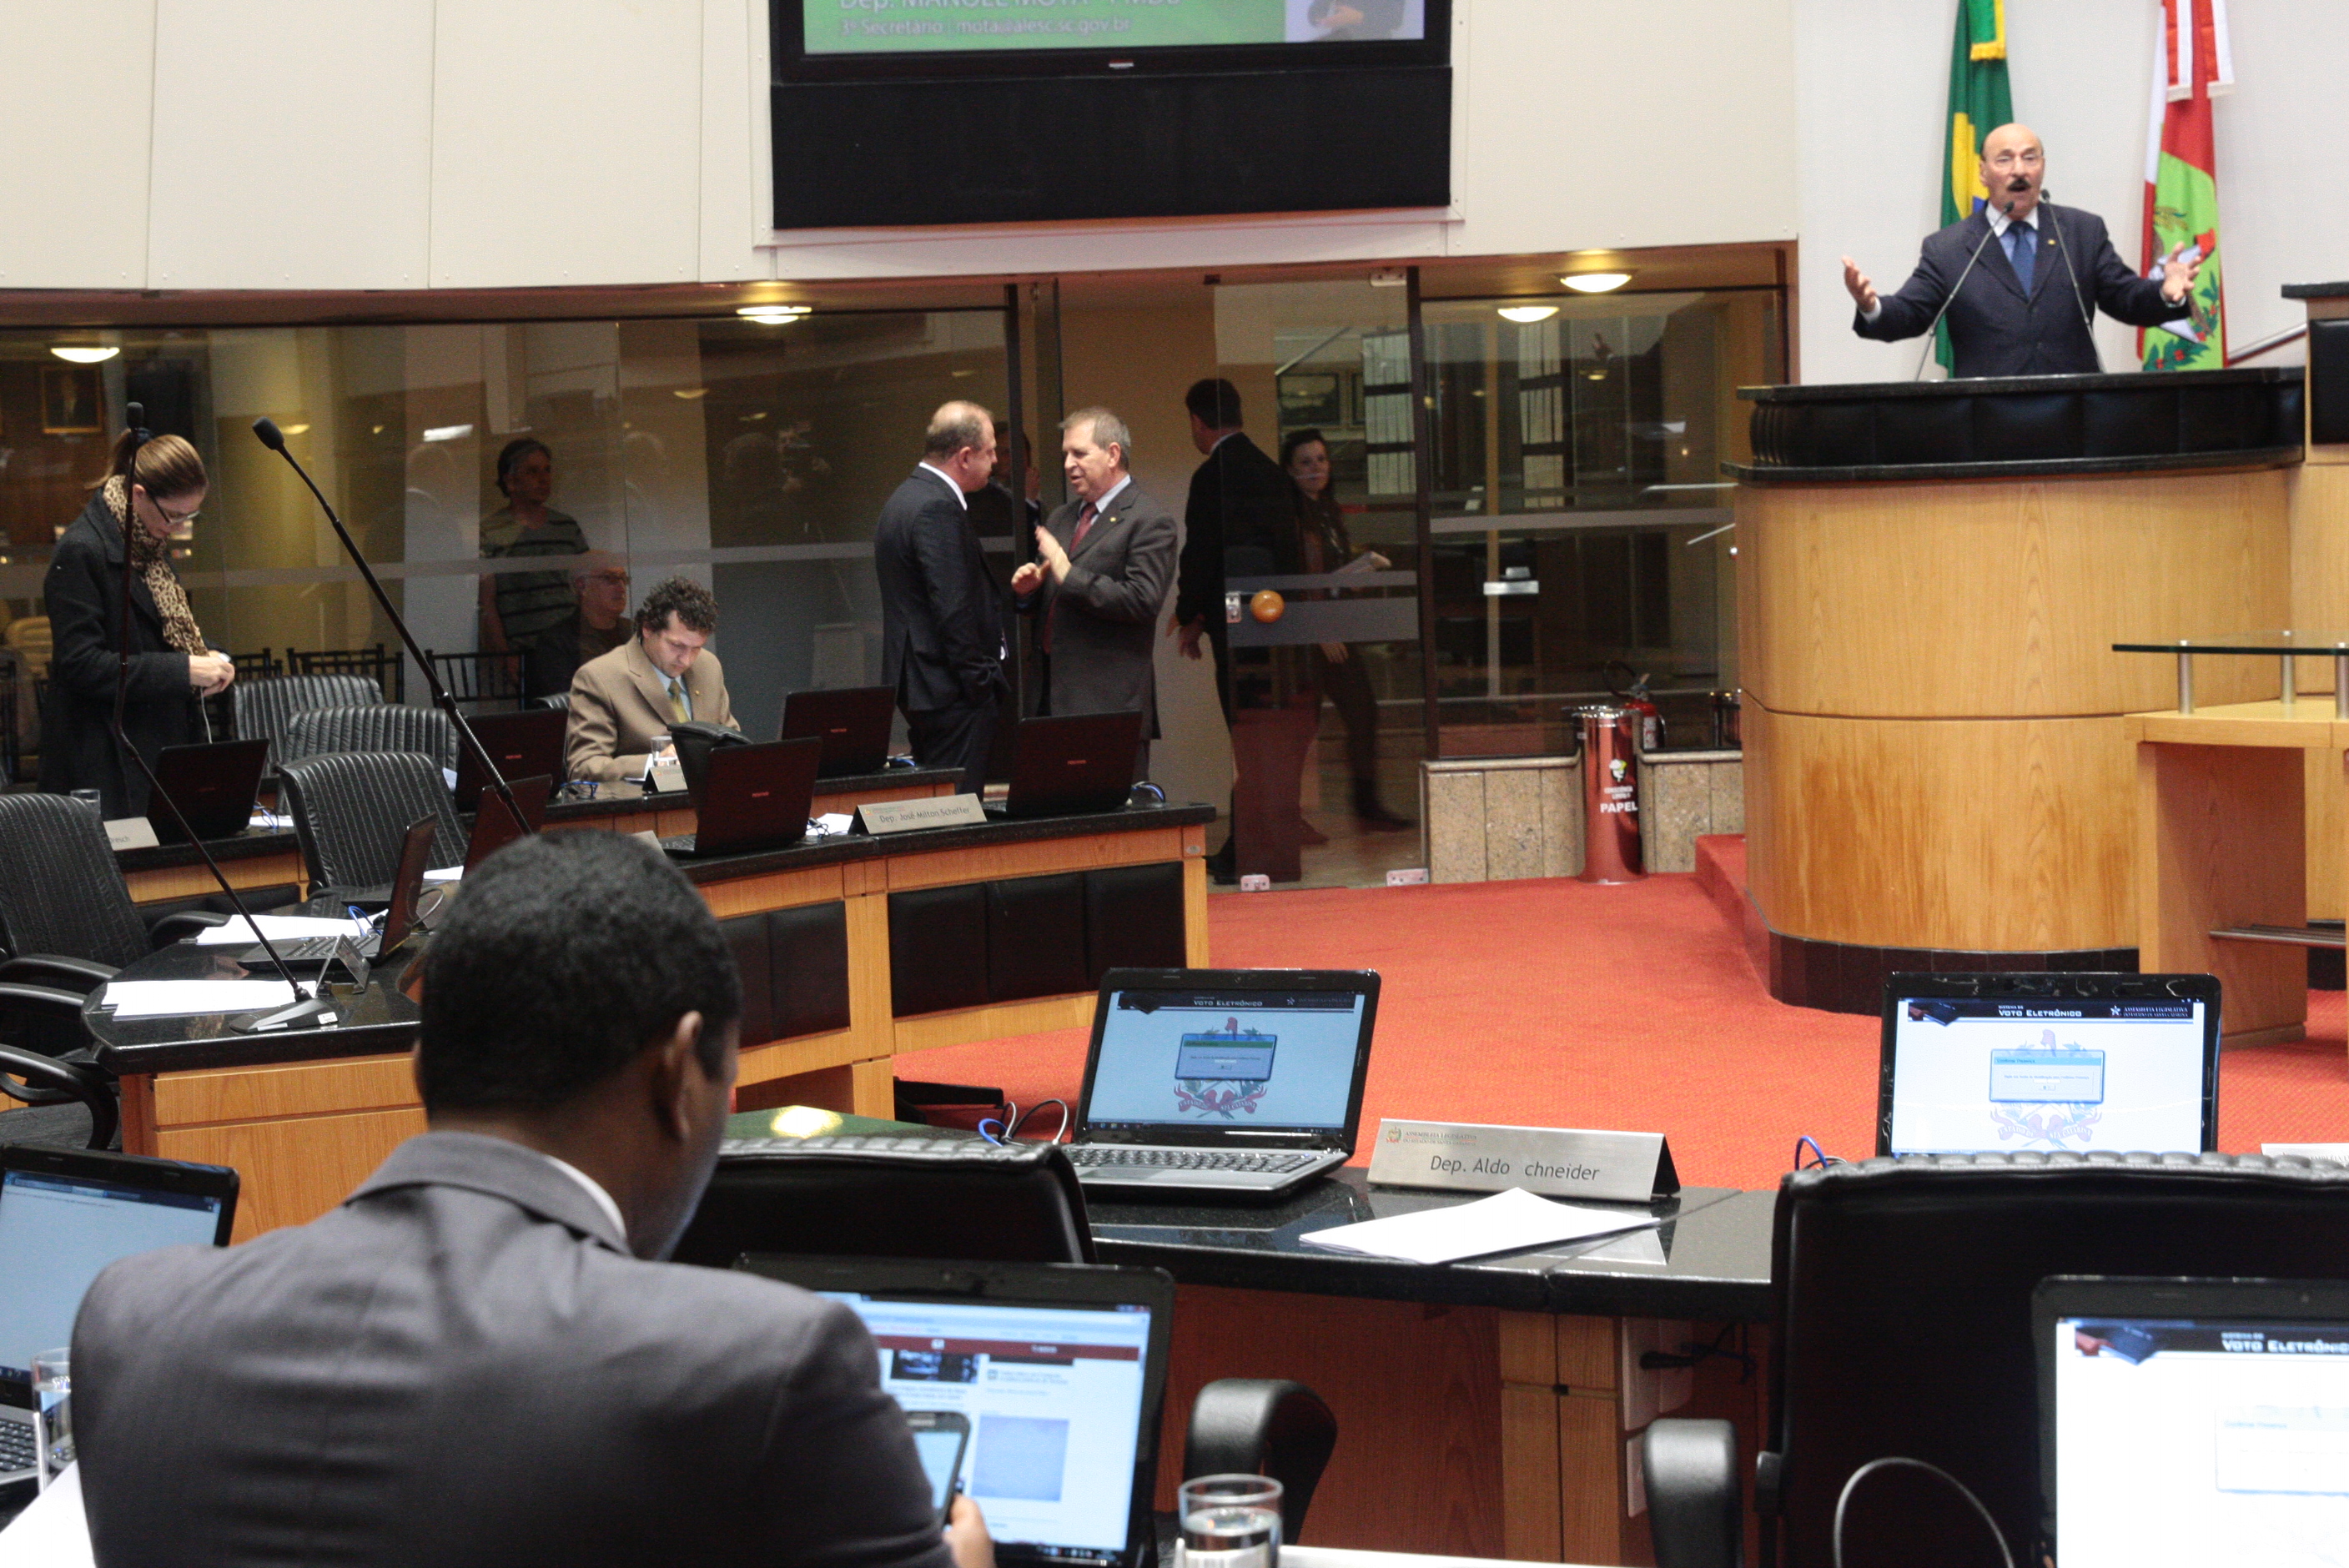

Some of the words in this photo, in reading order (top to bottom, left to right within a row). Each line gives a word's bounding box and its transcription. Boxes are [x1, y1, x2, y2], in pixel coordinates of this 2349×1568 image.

[1600, 802, 1638, 813] PAPEL
[878, 815, 898, 824] Dep.
[900, 812, 916, 822] José
[918, 810, 940, 819] Milton
[940, 807, 970, 817] Scheffer
[2026, 1008, 2082, 1017] ELETRÔNICO
[1430, 1155, 1466, 1175] Dep.
[1472, 1158, 1510, 1175] Aldo
[1524, 1160, 1600, 1181] chneider
[2222, 1339, 2263, 1352] VOTO
